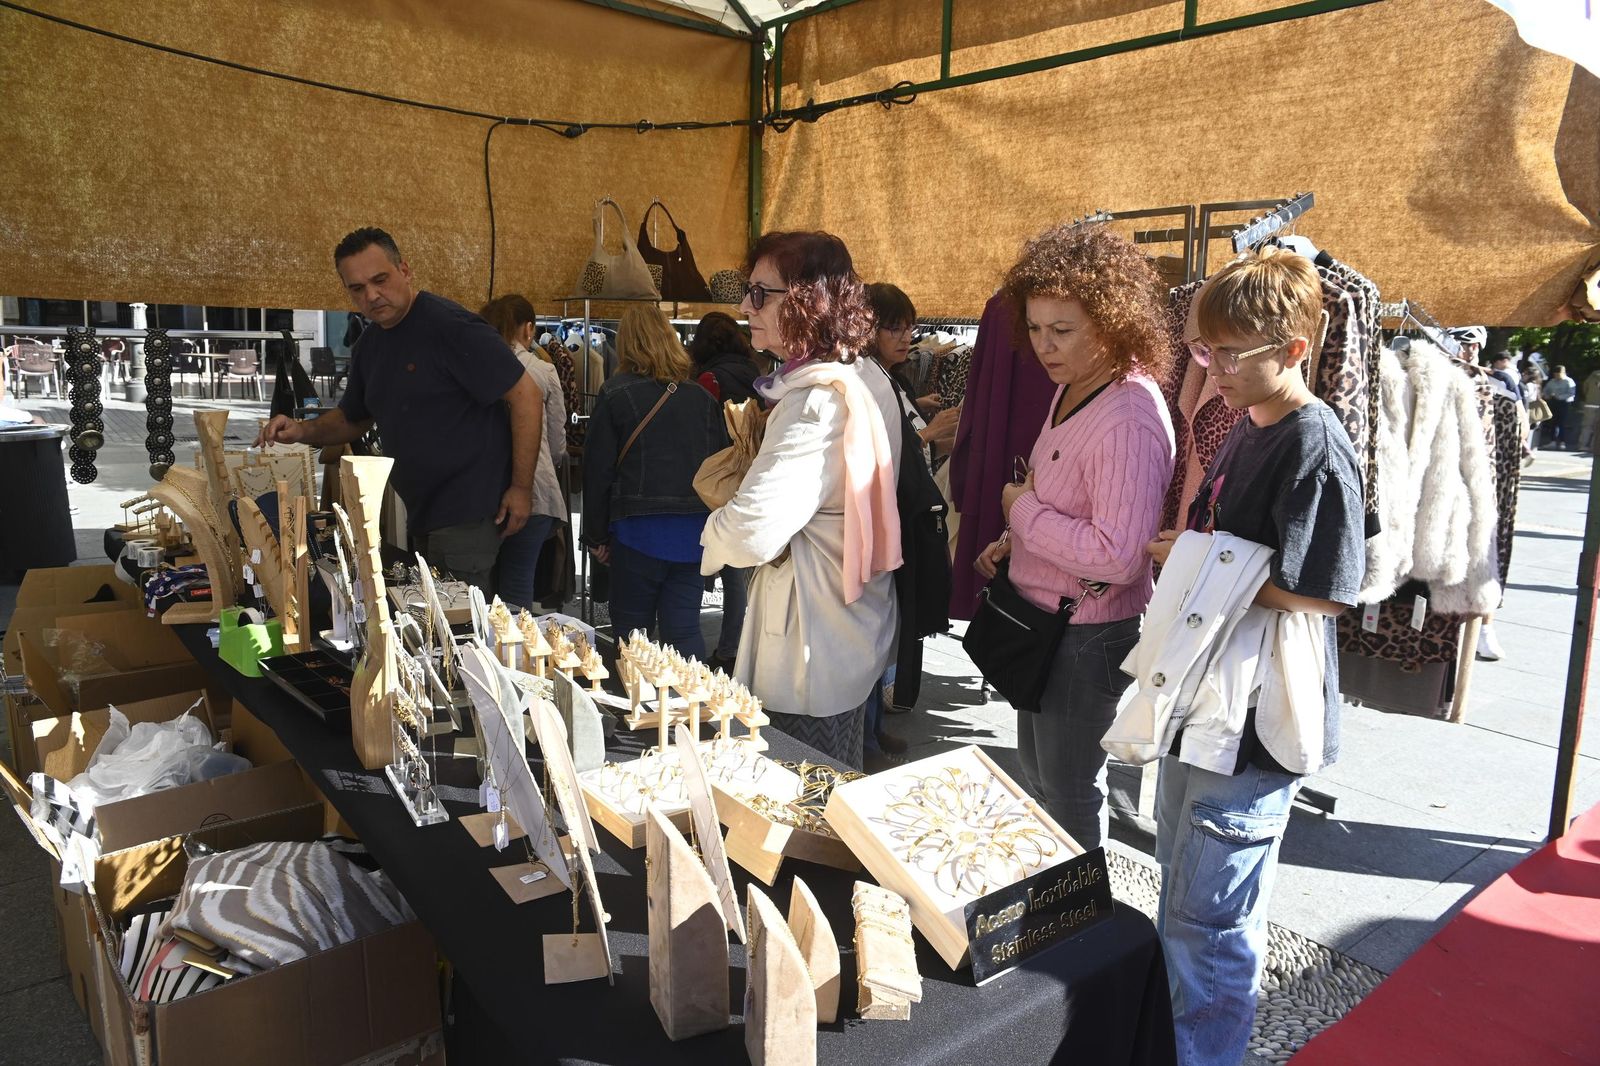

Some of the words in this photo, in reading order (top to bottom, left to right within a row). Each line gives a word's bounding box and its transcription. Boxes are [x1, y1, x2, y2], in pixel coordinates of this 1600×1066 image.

[976, 901, 1026, 940] Acero
[1027, 862, 1102, 913] Inoxidable
[991, 921, 1057, 965] Stainless
[1059, 899, 1097, 928] Steel
